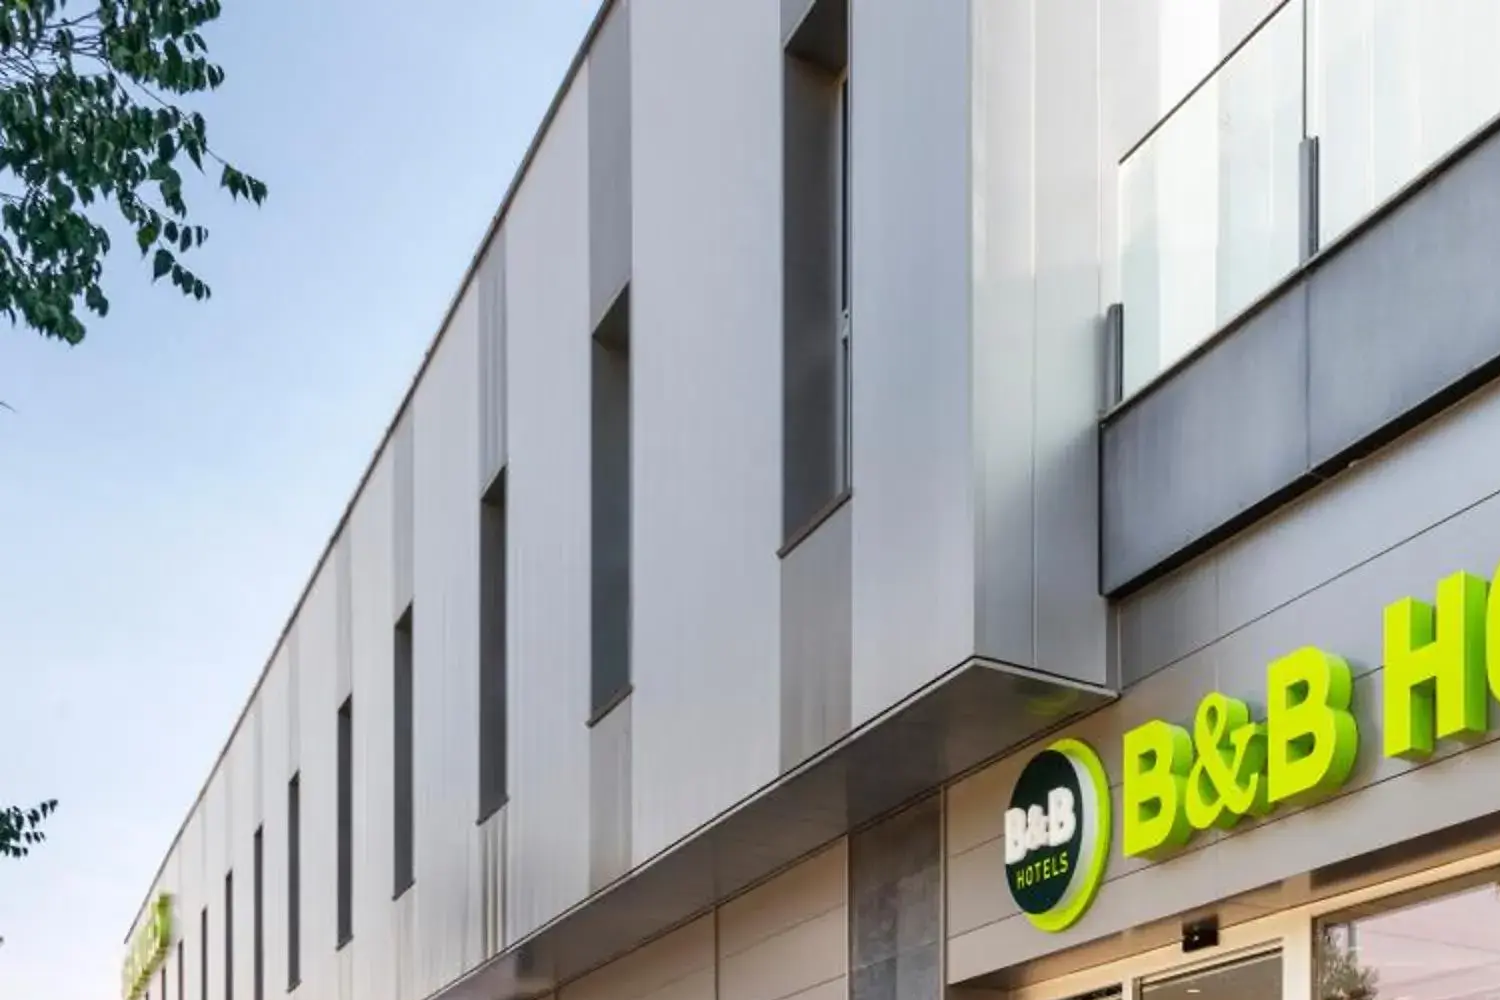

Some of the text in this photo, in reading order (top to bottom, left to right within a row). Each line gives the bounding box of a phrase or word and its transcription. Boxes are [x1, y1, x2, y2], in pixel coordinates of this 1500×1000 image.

[1122, 644, 1358, 860] B&B
[1004, 786, 1077, 865] B&B
[1016, 850, 1070, 890] HOTELS
